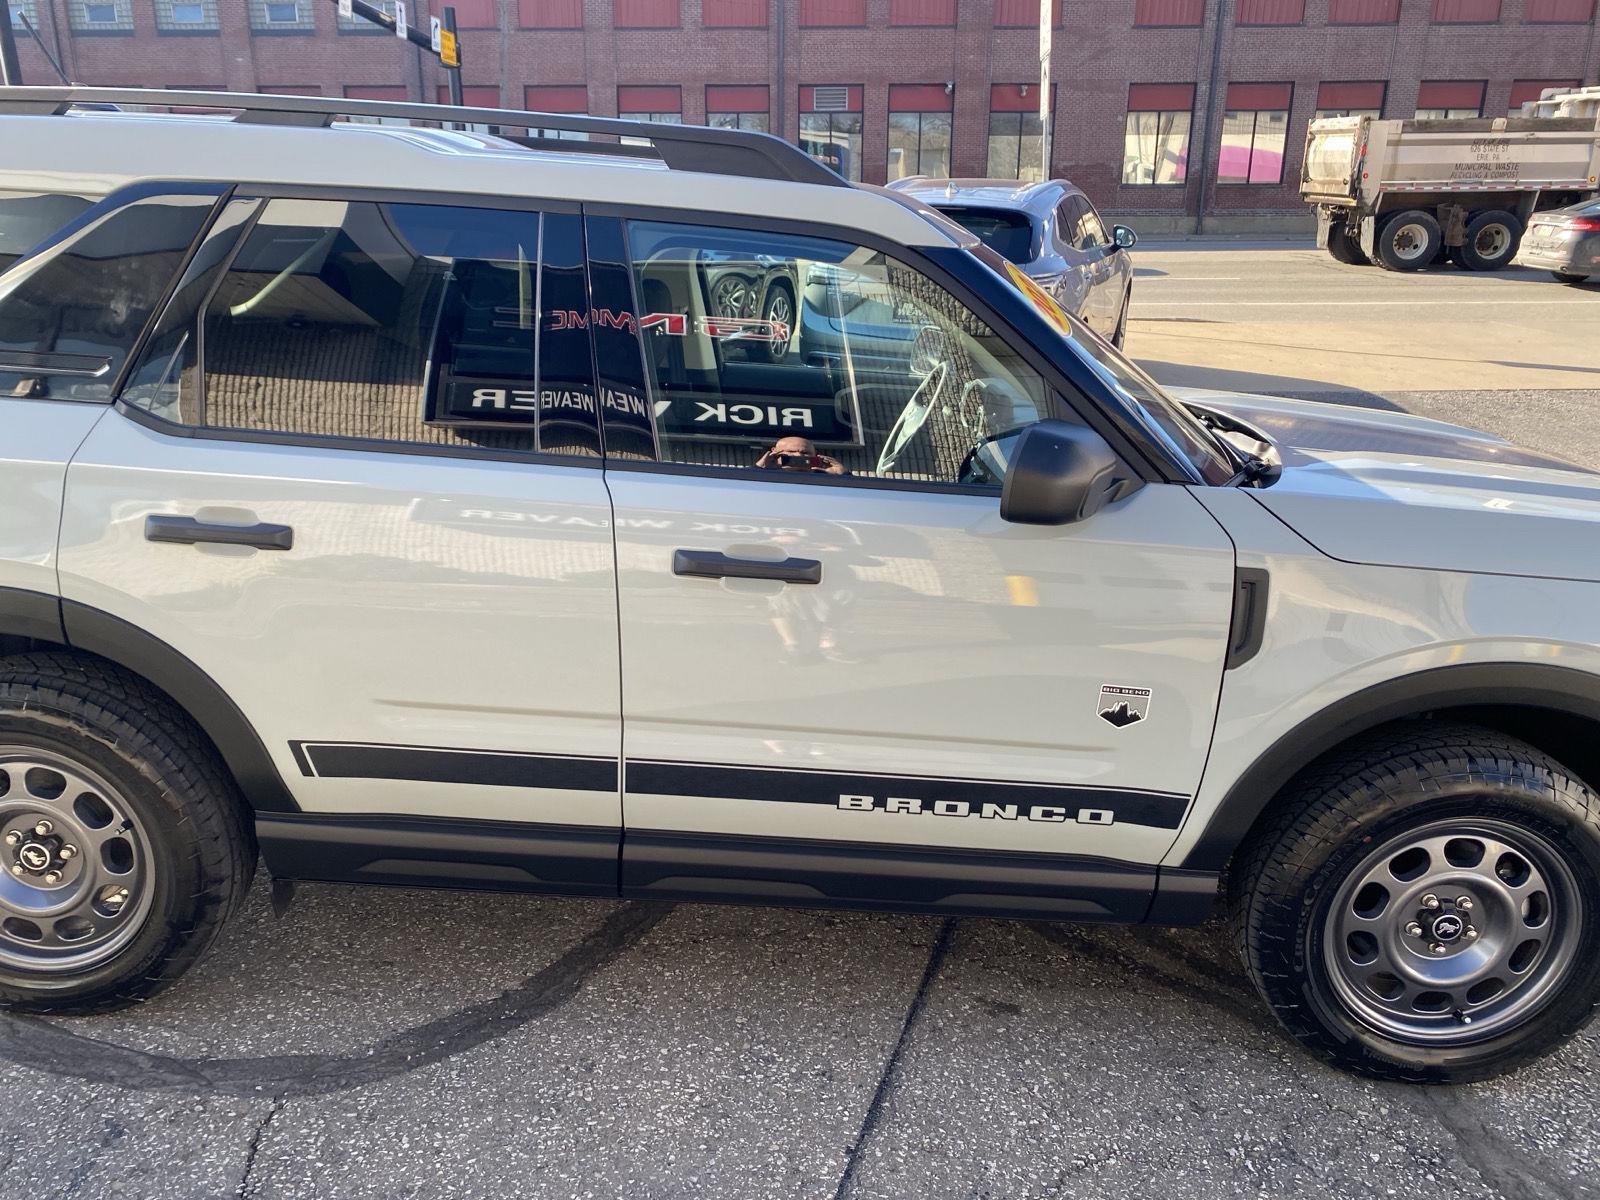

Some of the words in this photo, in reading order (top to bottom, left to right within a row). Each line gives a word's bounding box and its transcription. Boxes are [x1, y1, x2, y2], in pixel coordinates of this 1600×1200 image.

[1483, 144, 1500, 153] STATE
[1454, 162, 1492, 171] MUNICIPAL
[1495, 162, 1520, 171] WASTE
[1490, 171, 1520, 179] COMPOST
[1122, 688, 1149, 696] BEND
[836, 793, 1115, 826] BRONCO
